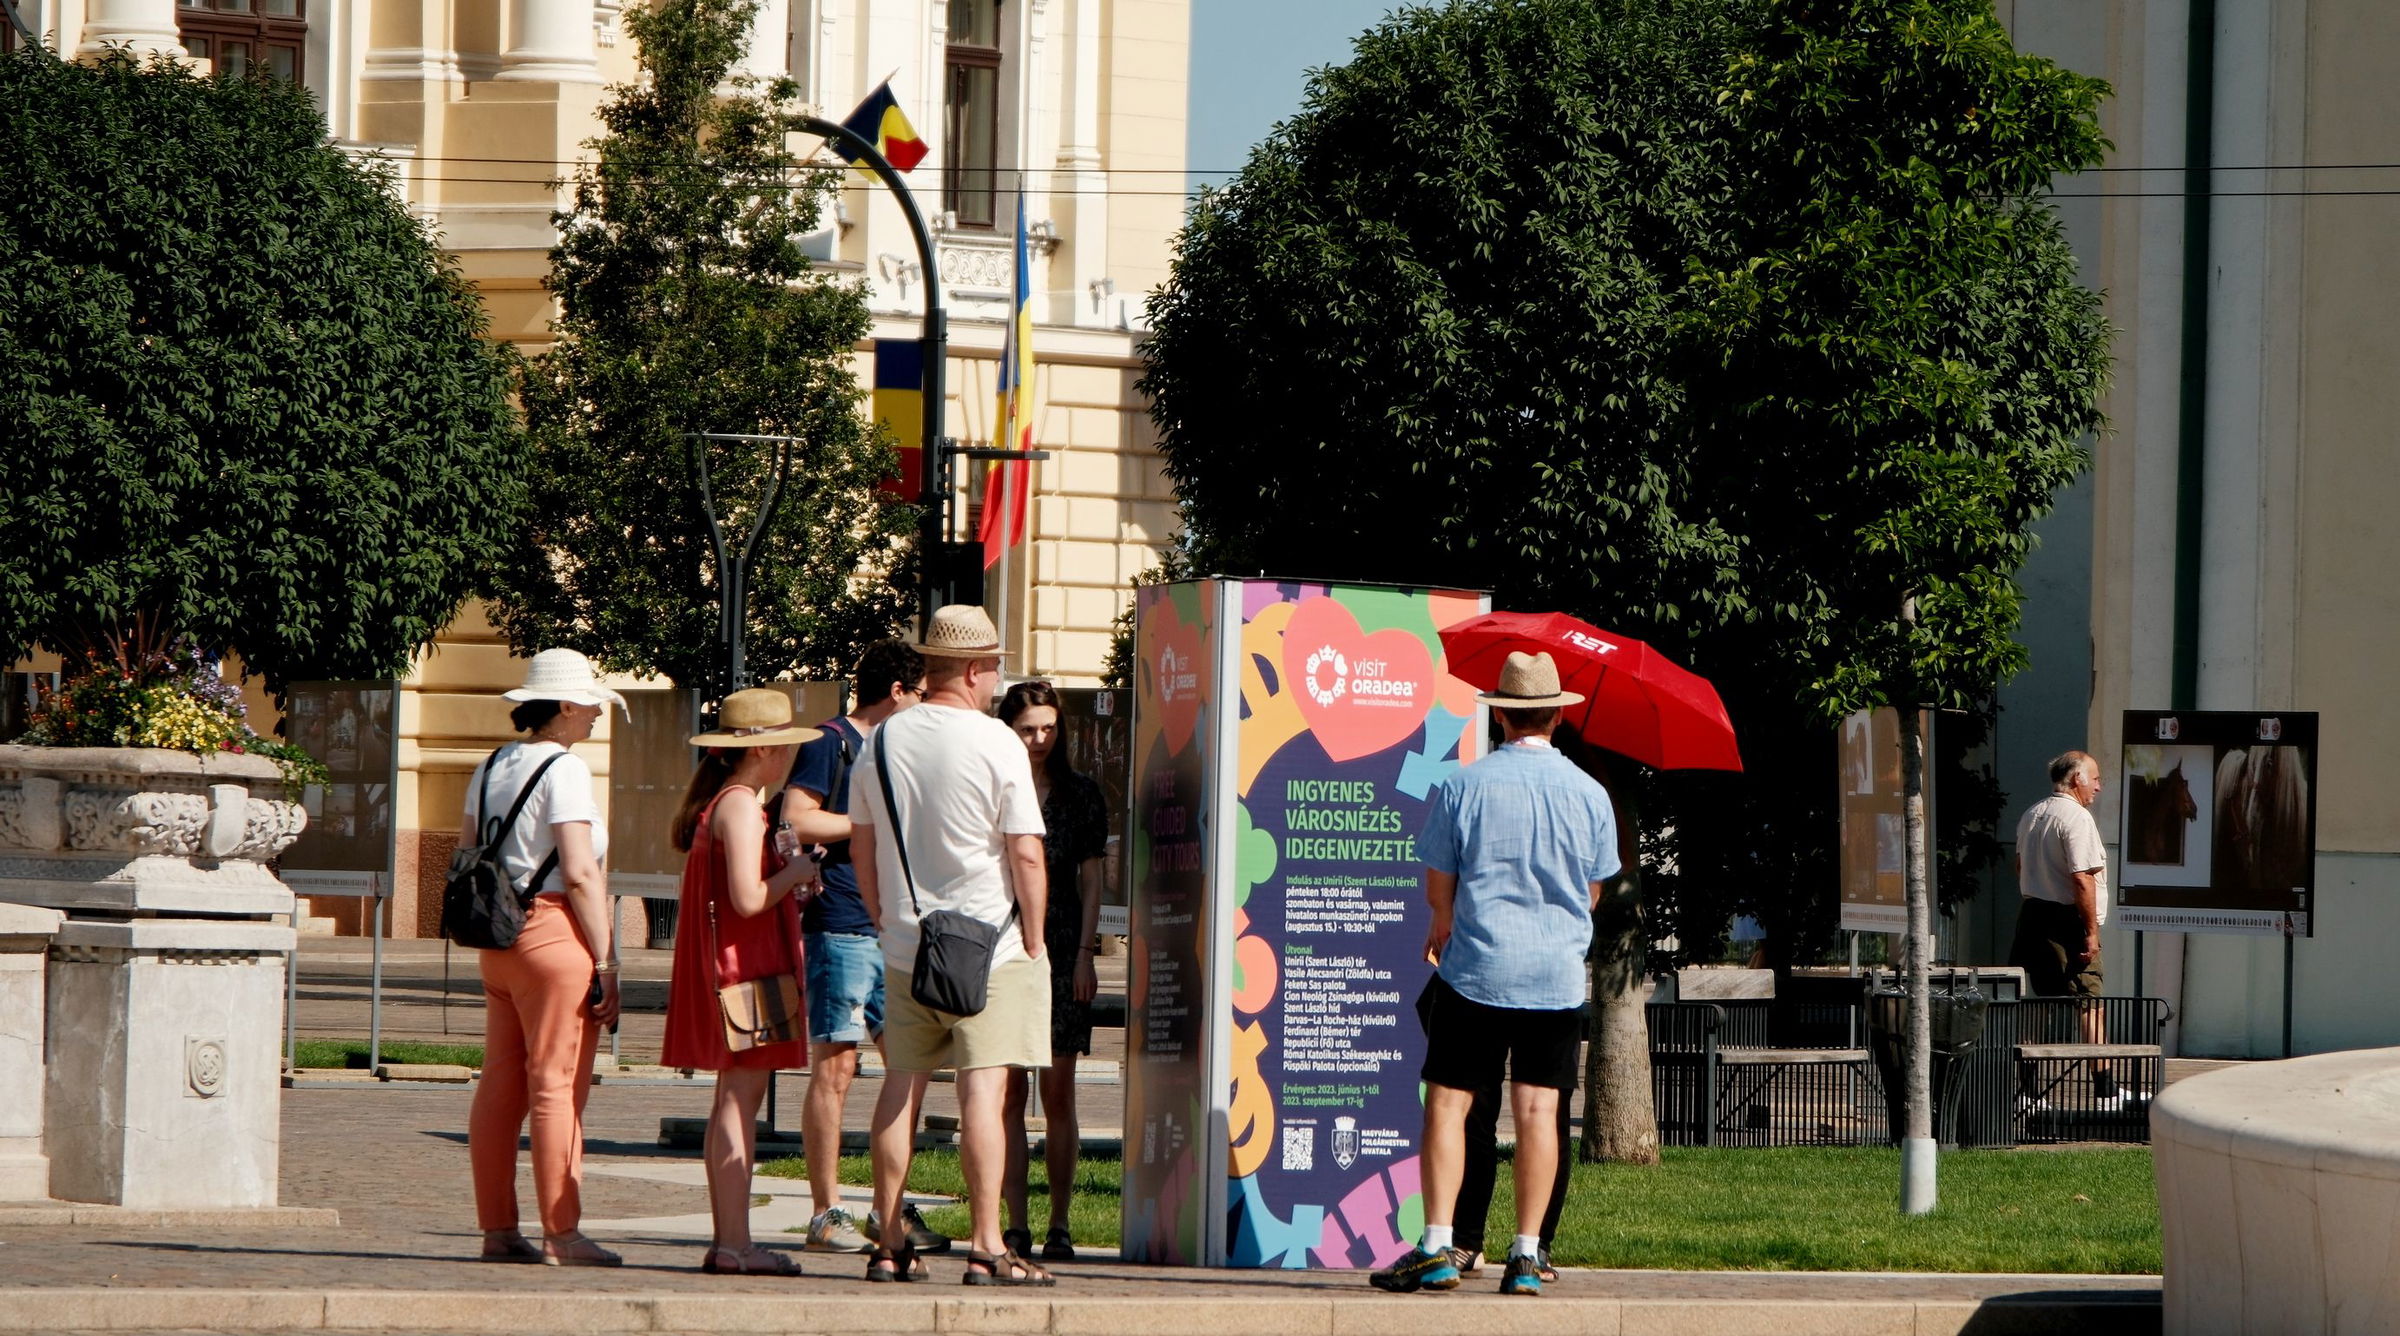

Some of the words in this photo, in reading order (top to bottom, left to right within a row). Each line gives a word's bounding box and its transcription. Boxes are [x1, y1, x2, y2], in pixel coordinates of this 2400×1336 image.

[1287, 780, 1374, 803] INGYENES
[1285, 803, 1401, 832] VÁROSNÉZÉS
[1285, 834, 1423, 862] IDEGENVEZETÉ
[1286, 876, 1312, 885] Indulás
[1323, 876, 1343, 886] Unirii
[1344, 876, 1367, 887] (Szent
[1369, 876, 1395, 887] László)
[1396, 877, 1418, 887] térről
[1286, 886, 1319, 898] pénteken
[1320, 888, 1339, 897] 18:00
[1341, 887, 1362, 898] órától
[1286, 899, 1324, 908] szombaton
[1326, 899, 1334, 908] és
[1336, 899, 1371, 911] vasárnap,
[1372, 900, 1404, 910] valamint
[1286, 910, 1318, 920] hivatalos
[1319, 911, 1369, 921] munkaszüneti
[1371, 912, 1403, 923] napokon
[1285, 921, 1323, 933] (augusztus
[1325, 922, 1337, 933] 15.)
[1343, 922, 1375, 933] 10:30-tól
[1285, 944, 1312, 955] Útvonal
[1285, 957, 1304, 966] Unirii
[1305, 956, 1328, 968] (Szent
[1329, 957, 1354, 968] László)
[1356, 957, 1366, 966] tér
[1285, 969, 1306, 978] Vasile
[1307, 968, 1344, 978] Alecsandri
[1346, 968, 1374, 979] (Zöldfa)
[1376, 971, 1391, 979] utca
[1285, 980, 1307, 989] Fekete
[1309, 980, 1321, 989] Sas
[1323, 980, 1346, 990] palota
[1302, 991, 1326, 1003] Neológ
[1328, 992, 1364, 1004] Zsinagóga
[1366, 992, 1399, 1004] (kívülről)
[1284, 1003, 1303, 1013] Szent
[1305, 1003, 1327, 1013] László
[1328, 1003, 1340, 1013] híd
[1323, 1015, 1361, 1025] Roche-ház
[1362, 1015, 1396, 1026] (kívülről)
[1284, 1026, 1319, 1036] Ferdinand
[1320, 1027, 1349, 1037] (Bémer)
[1350, 1028, 1361, 1036] tér
[1283, 1038, 1318, 1049] Republicii
[1335, 1039, 1351, 1048] utca
[1283, 1049, 1305, 1059] Római
[1307, 1050, 1340, 1059] Katolikus
[1342, 1050, 1391, 1061] Székesegyház
[1393, 1050, 1402, 1060] és
[1283, 1061, 1311, 1072] Püspöki
[1313, 1061, 1335, 1071] Palota
[1337, 1061, 1380, 1073] (opcionális)
[1283, 1082, 1316, 1096] Érvényes:
[1318, 1085, 1336, 1094] 2023.
[1338, 1084, 1360, 1095] június
[1283, 1097, 1300, 1105] 2023.
[1303, 1097, 1345, 1107] szeptember
[1347, 1097, 1364, 1108] 17-ig
